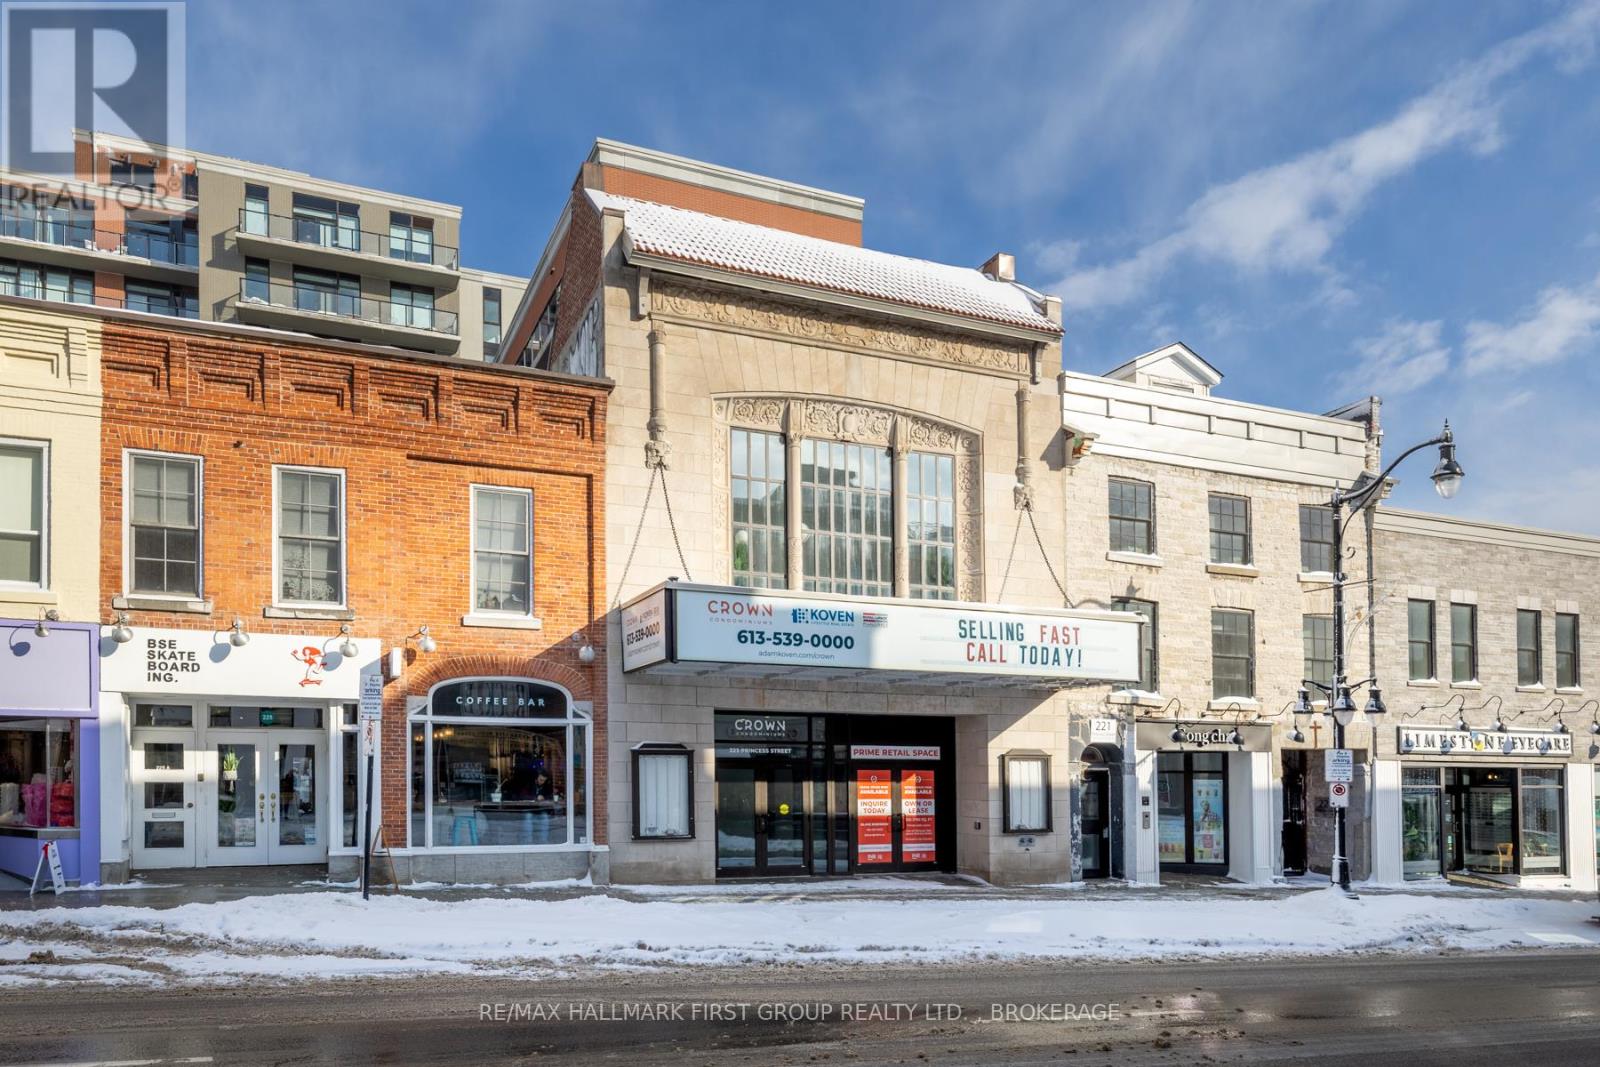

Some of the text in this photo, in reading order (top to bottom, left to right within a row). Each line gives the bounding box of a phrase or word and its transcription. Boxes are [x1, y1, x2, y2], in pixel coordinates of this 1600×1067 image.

[708, 600, 773, 616] CROWN
[811, 608, 855, 622] KOVEN
[958, 619, 1080, 646] SELLING FAST
[147, 639, 177, 649] BSE
[737, 629, 855, 650] 613-539-0000
[147, 650, 196, 661] SKATE
[967, 642, 1082, 667] CALL TODAY!
[147, 661, 201, 672] BOARD
[147, 672, 178, 682] ING.
[456, 696, 545, 706] COFFEE BAR
[735, 719, 786, 731] CROWN
[1180, 729, 1234, 746] ong ch
